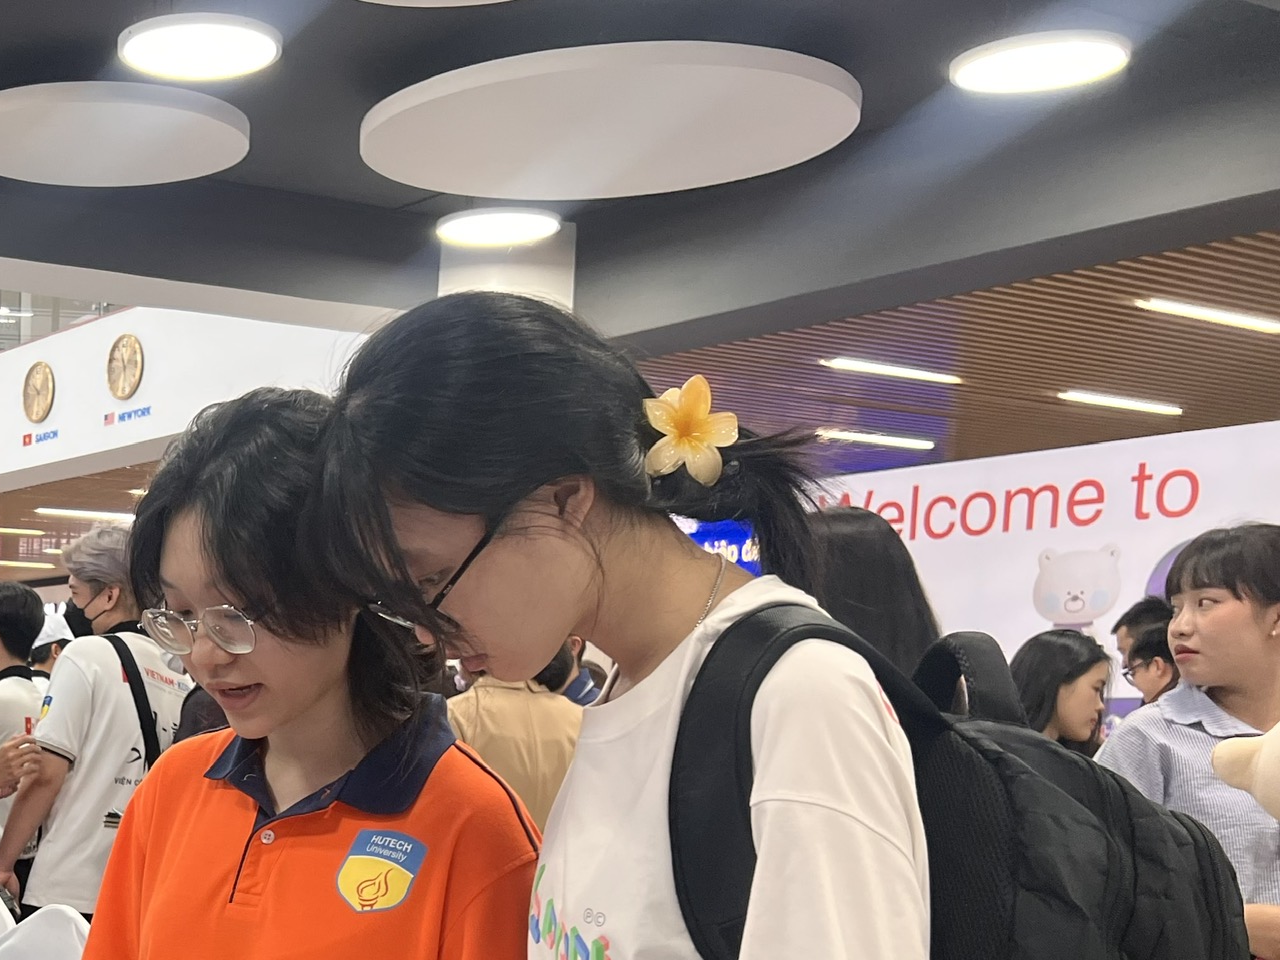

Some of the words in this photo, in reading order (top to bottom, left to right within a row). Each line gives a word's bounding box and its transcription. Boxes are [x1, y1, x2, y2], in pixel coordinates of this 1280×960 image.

[35, 430, 59, 443] SAIGON
[1131, 462, 1201, 521] to
[366, 843, 407, 863] University
[370, 835, 412, 853] HUTECH
